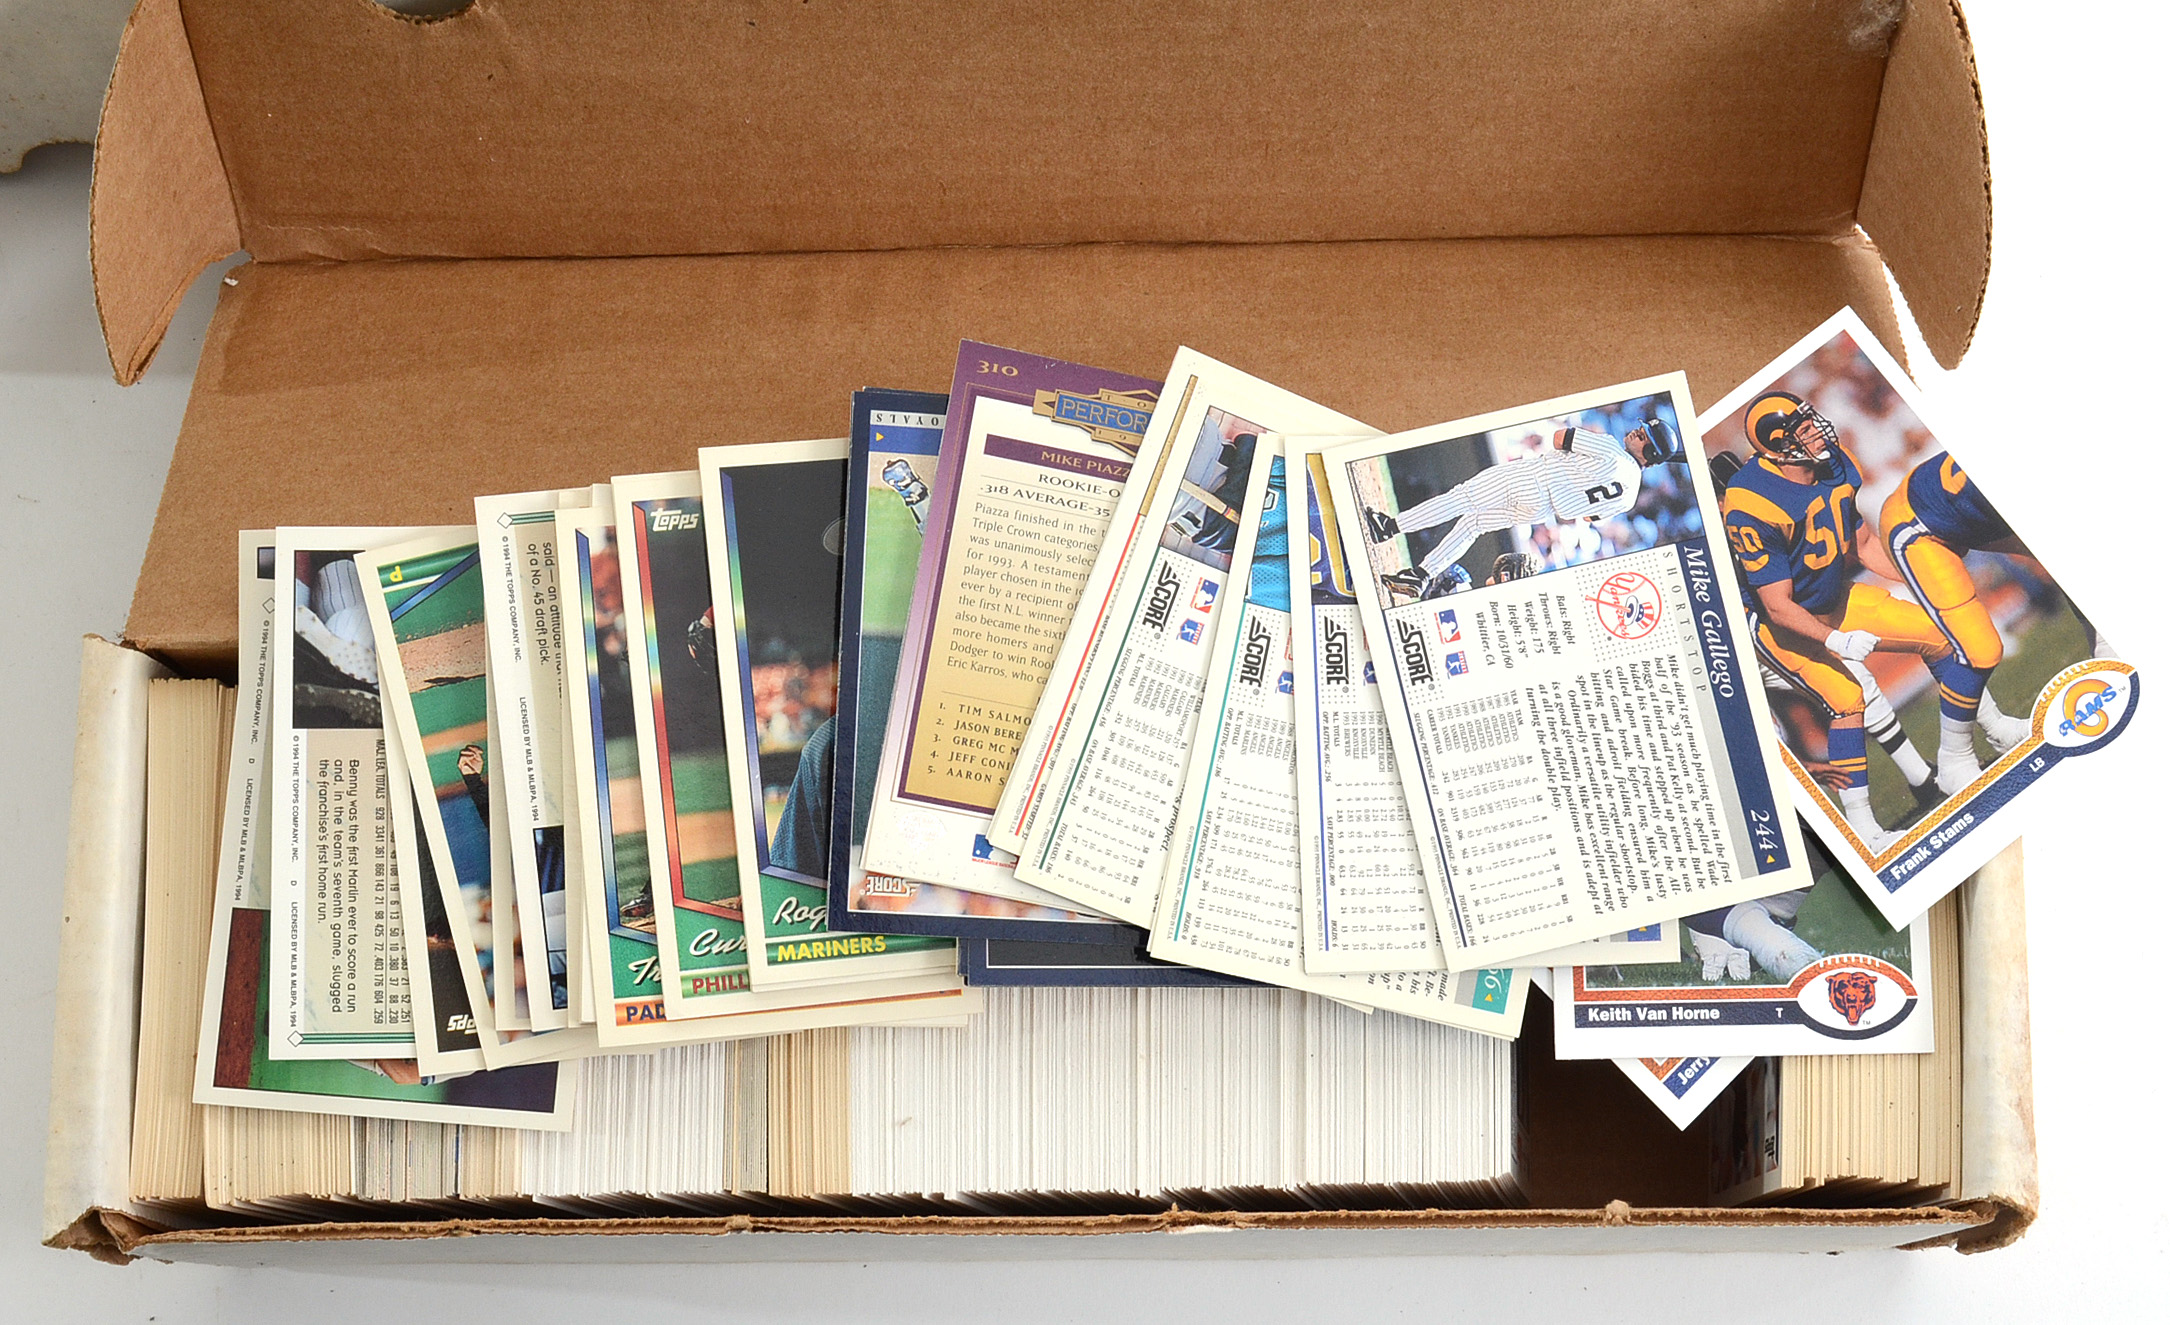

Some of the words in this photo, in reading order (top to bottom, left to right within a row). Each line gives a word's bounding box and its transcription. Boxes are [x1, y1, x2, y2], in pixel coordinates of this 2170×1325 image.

[976, 360, 1019, 377] 310
[1041, 451, 1082, 468] MIKE
[1585, 481, 1623, 504] 2
[972, 516, 1003, 533] Triple
[1006, 524, 1041, 540] Crown
[974, 501, 1009, 518] Piazza
[1013, 509, 1059, 528] finished
[1063, 520, 1074, 531] in
[1078, 523, 1096, 536] the
[1803, 482, 1854, 570] 50
[526, 543, 540, 555] of
[542, 541, 555, 566] said
[966, 547, 984, 560] for
[988, 554, 1015, 569] 1993.
[1020, 559, 1028, 570] A
[969, 534, 990, 546] was
[994, 540, 1062, 563] unanimously
[529, 558, 539, 566] a
[530, 568, 542, 589] No.
[962, 564, 998, 579] player
[1000, 571, 1038, 587] chosen
[1040, 579, 1051, 590] in
[1054, 581, 1072, 594] the
[533, 591, 545, 605] 45
[547, 585, 557, 601] an
[960, 581, 985, 592] ever
[988, 583, 1002, 598] by
[1005, 590, 1012, 598] a
[1015, 592, 1063, 608] recipient
[1066, 599, 1078, 611] of
[1142, 561, 1180, 632] SCORE
[958, 594, 976, 607] the
[979, 597, 1000, 612] first
[1004, 603, 1024, 616] N.L.
[1027, 608, 1065, 624] winner
[1506, 604, 1522, 637] Height:
[1555, 595, 1567, 618] Bats:
[1561, 620, 1576, 644] Right
[1683, 545, 1711, 602] Mike
[1701, 610, 1734, 698] Gallego
[534, 608, 548, 636] draft
[954, 610, 977, 623] also
[979, 613, 1021, 632] became
[1023, 623, 1041, 636] the
[1489, 601, 1501, 626] Born:
[1496, 630, 1514, 668] 10/31/60
[1524, 600, 1538, 634] Weight:
[1532, 638, 1544, 653] 175
[1538, 592, 1553, 628] Throws:
[1547, 630, 1561, 654] Right
[952, 627, 982, 640] more
[986, 630, 1028, 649] homers
[1032, 643, 1054, 654] and
[1324, 615, 1350, 685] SCORE
[1475, 611, 1490, 652] Whittier,
[1485, 654, 1496, 666] CA
[535, 638, 550, 665] pick.
[949, 640, 989, 657] Dodger
[992, 650, 1003, 660] to
[1007, 654, 1026, 665] win
[1239, 615, 1271, 688] SCORE
[1396, 618, 1434, 687] SCORE
[946, 655, 968, 669] Eric
[970, 660, 1007, 678] Karros,
[1011, 669, 1034, 682] who
[1654, 657, 1668, 679] half
[1666, 654, 1679, 678] Mike
[1658, 683, 1673, 695] of
[1673, 681, 1688, 711] didn't
[958, 703, 982, 716] TIM
[1664, 700, 1675, 715] the
[2058, 685, 2118, 737] RAMS
[953, 719, 990, 734] JASON
[1679, 713, 1693, 729] get
[952, 735, 983, 749] GREG
[988, 742, 1006, 754] MC
[1686, 732, 1701, 759] much
[318, 759, 330, 778] the
[947, 751, 976, 764] JEFF
[1675, 742, 1690, 777] season
[2028, 757, 2046, 772] LB
[333, 758, 345, 785] and,
[346, 758, 360, 796] Benny
[946, 767, 992, 783] AARON
[1691, 761, 1709, 801] playing
[333, 790, 344, 801] in
[1685, 782, 1694, 794] as
[316, 780, 330, 841] franchise's
[333, 806, 344, 825] the
[348, 799, 357, 821] was
[1690, 800, 1700, 812] he
[1704, 803, 1716, 826] time
[348, 824, 359, 843] the
[1692, 817, 1713, 854] spelled
[1711, 829, 1720, 840] in
[1751, 809, 1771, 851] 244
[315, 844, 329, 864] first
[333, 830, 344, 868] team's
[346, 845, 359, 866] first
[1714, 842, 1725, 858] the
[1890, 845, 1932, 880] Frank
[1929, 813, 1975, 850] Stams
[317, 866, 329, 899] home
[1706, 860, 1719, 886] Wade
[1716, 860, 1732, 883] first
[332, 872, 343, 918] seventh
[348, 869, 359, 902] Marlin
[317, 902, 326, 923] run.
[347, 906, 357, 931] ever
[329, 922, 341, 959] game,
[347, 933, 358, 945] to
[777, 936, 887, 962] MARINERS
[347, 948, 356, 980] score
[329, 964, 343, 1012] slugged
[347, 982, 356, 991] a
[346, 994, 356, 1013] run
[1588, 1007, 1632, 1022] Keith
[1637, 1007, 1668, 1021] Van
[1672, 1005, 1721, 1020] Horne
[1775, 1007, 1784, 1018] T
[1676, 1055, 1712, 1086] Jerry
